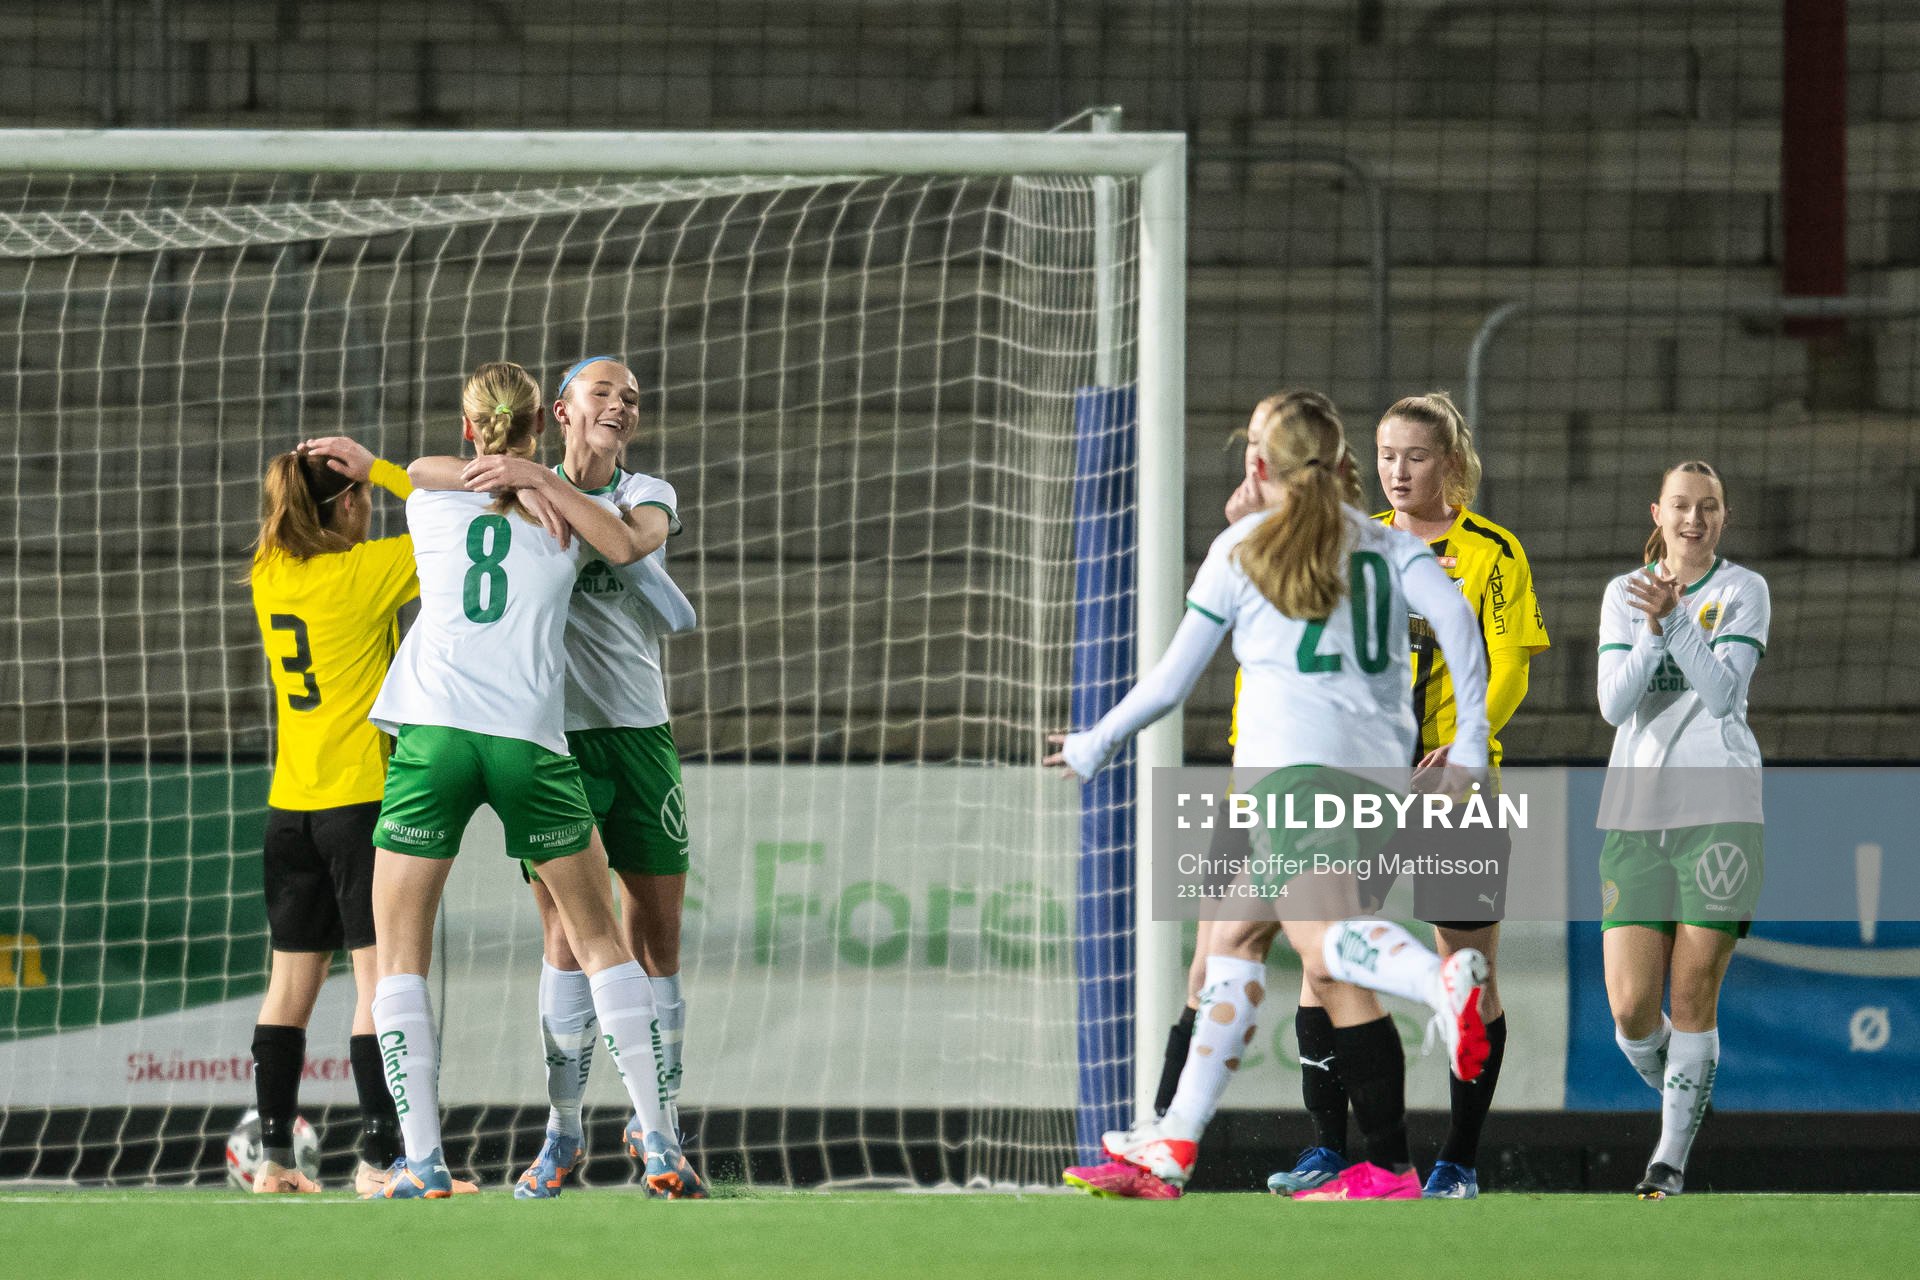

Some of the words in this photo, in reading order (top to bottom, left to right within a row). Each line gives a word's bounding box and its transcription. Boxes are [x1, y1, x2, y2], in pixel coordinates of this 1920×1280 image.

[462, 513, 511, 623] 8
[1296, 551, 1391, 674] 20
[1489, 564, 1508, 636] stadium
[270, 613, 321, 711] 3
[383, 819, 445, 840] BOSPHORUS
